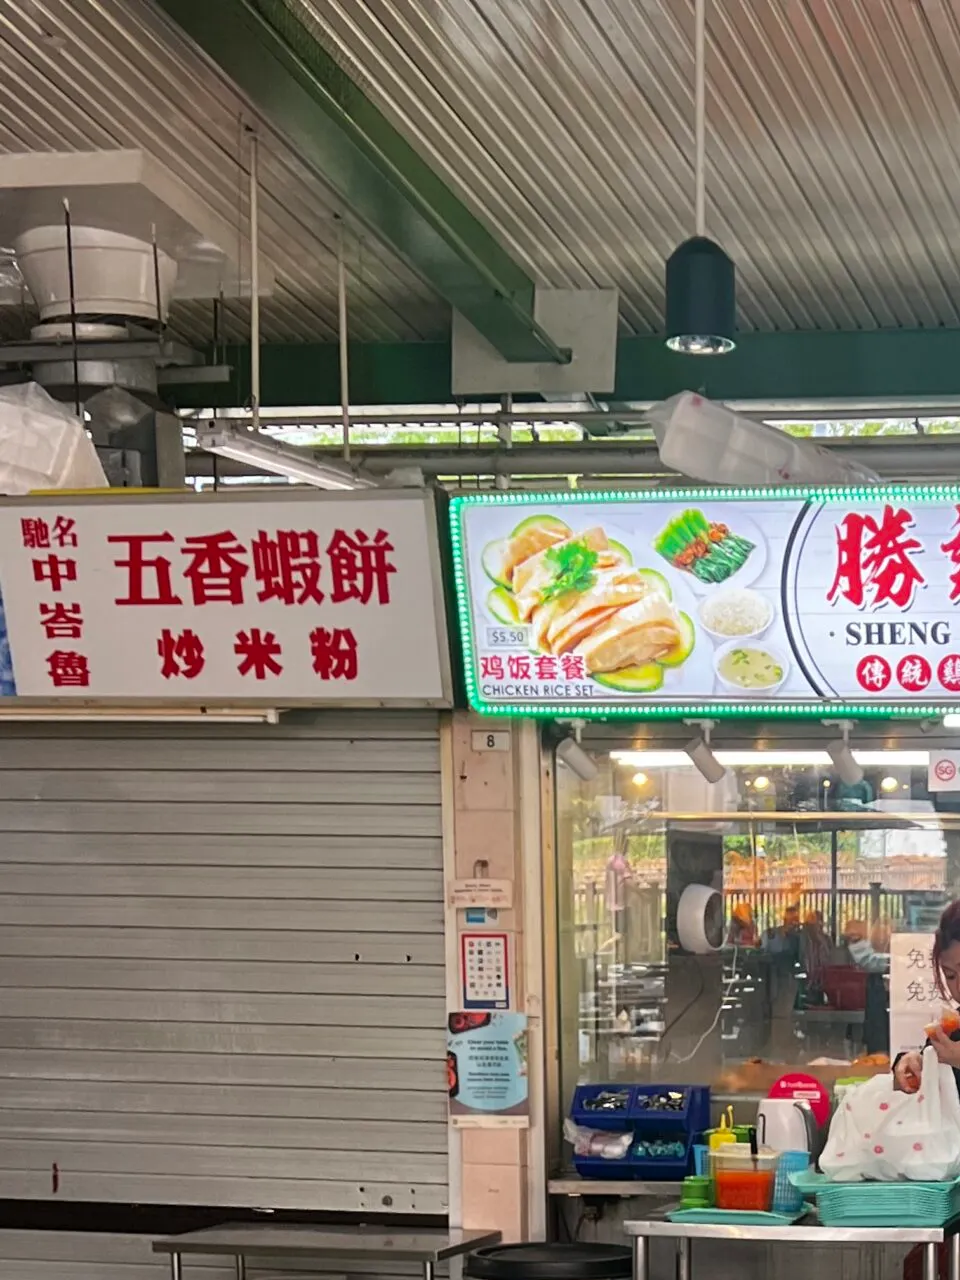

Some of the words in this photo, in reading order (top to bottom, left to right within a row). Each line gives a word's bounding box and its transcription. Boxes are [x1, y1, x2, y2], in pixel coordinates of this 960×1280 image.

[20, 515, 79, 549] 馳名
[107, 528, 398, 607] 五香蝦餅
[31, 553, 91, 688] 中峇魯
[492, 630, 524, 643] $5.50
[845, 621, 951, 646] SHENG
[156, 626, 359, 681] 炒米粉
[479, 655, 585, 680] 鸡饭套餐
[482, 684, 540, 696] CHICKEN
[543, 684, 571, 696] RICE
[575, 684, 594, 697] SET
[486, 734, 496, 748] 8
[938, 764, 953, 776] SG
